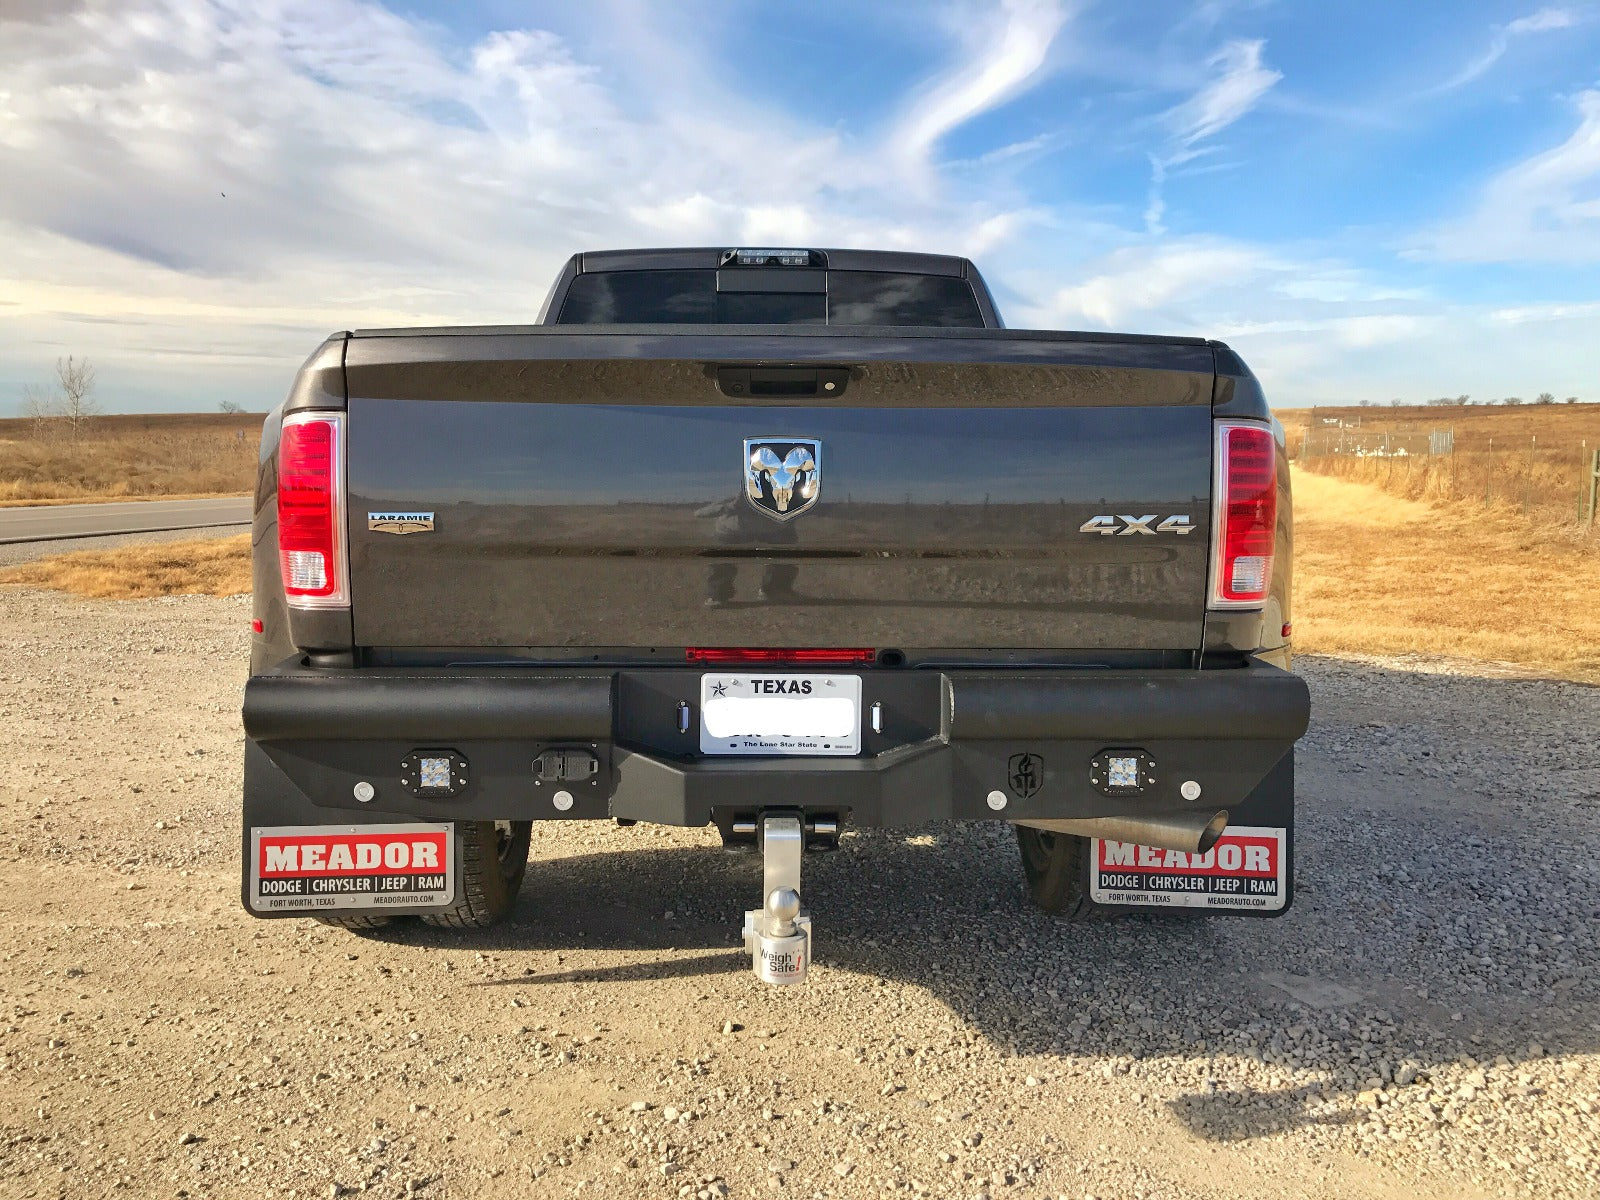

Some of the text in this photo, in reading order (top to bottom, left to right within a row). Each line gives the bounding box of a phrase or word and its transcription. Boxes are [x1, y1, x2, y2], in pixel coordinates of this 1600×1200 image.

[751, 680, 813, 694] TEXAS
[264, 842, 439, 872] MEADOR
[1104, 840, 1271, 872] MEADOR
[262, 876, 444, 894] DODGE CHRYSLER JEEP RAM
[1101, 874, 1276, 893] DODGE CHRYSLER JEEP RAM
[269, 899, 287, 907] FORT
[1126, 894, 1151, 902] WORTH,
[1207, 897, 1266, 906] MEADORAUTO.COM
[760, 946, 792, 965] Weigh
